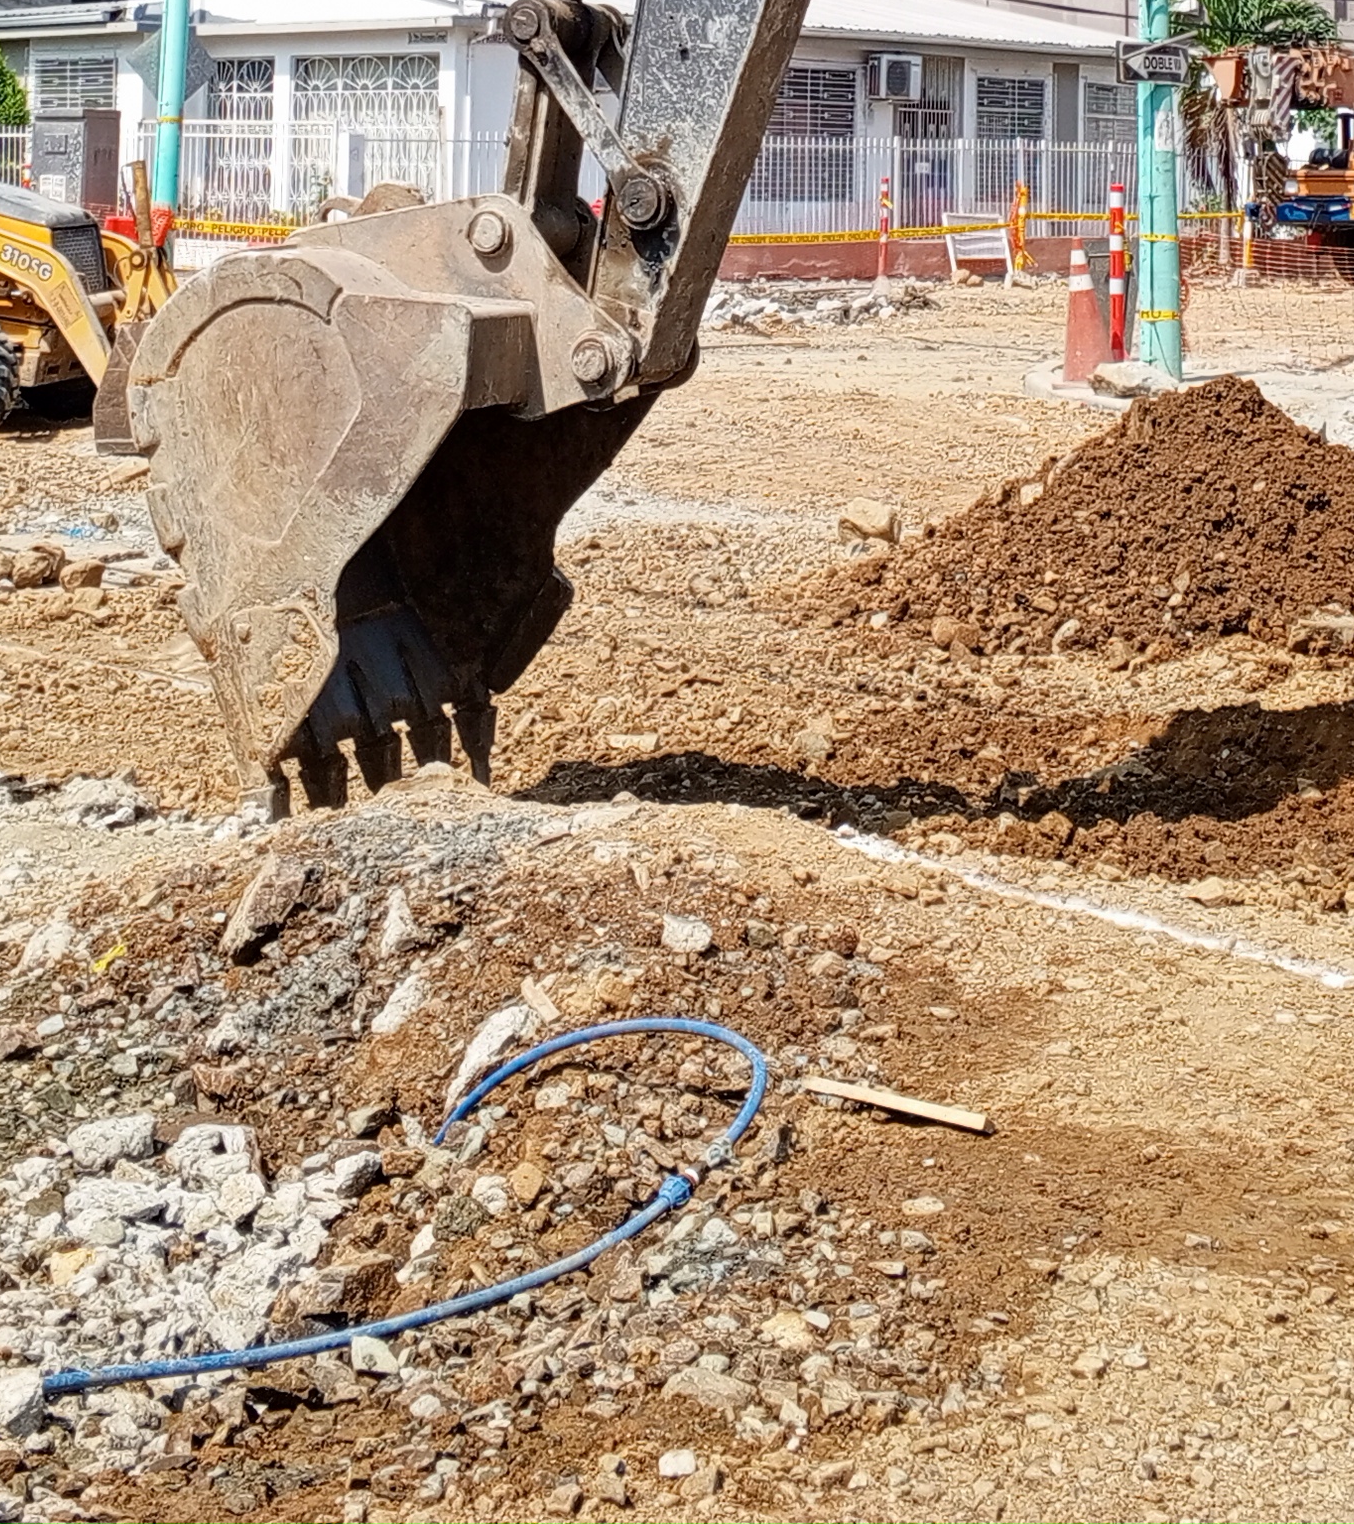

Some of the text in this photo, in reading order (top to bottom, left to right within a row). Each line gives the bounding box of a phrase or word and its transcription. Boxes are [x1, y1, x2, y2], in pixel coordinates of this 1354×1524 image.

[1144, 56, 1173, 70] DOBLE
[211, 223, 255, 235] PELIGRO
[261, 227, 291, 237] PELIG
[0, 244, 52, 281] 310SG
